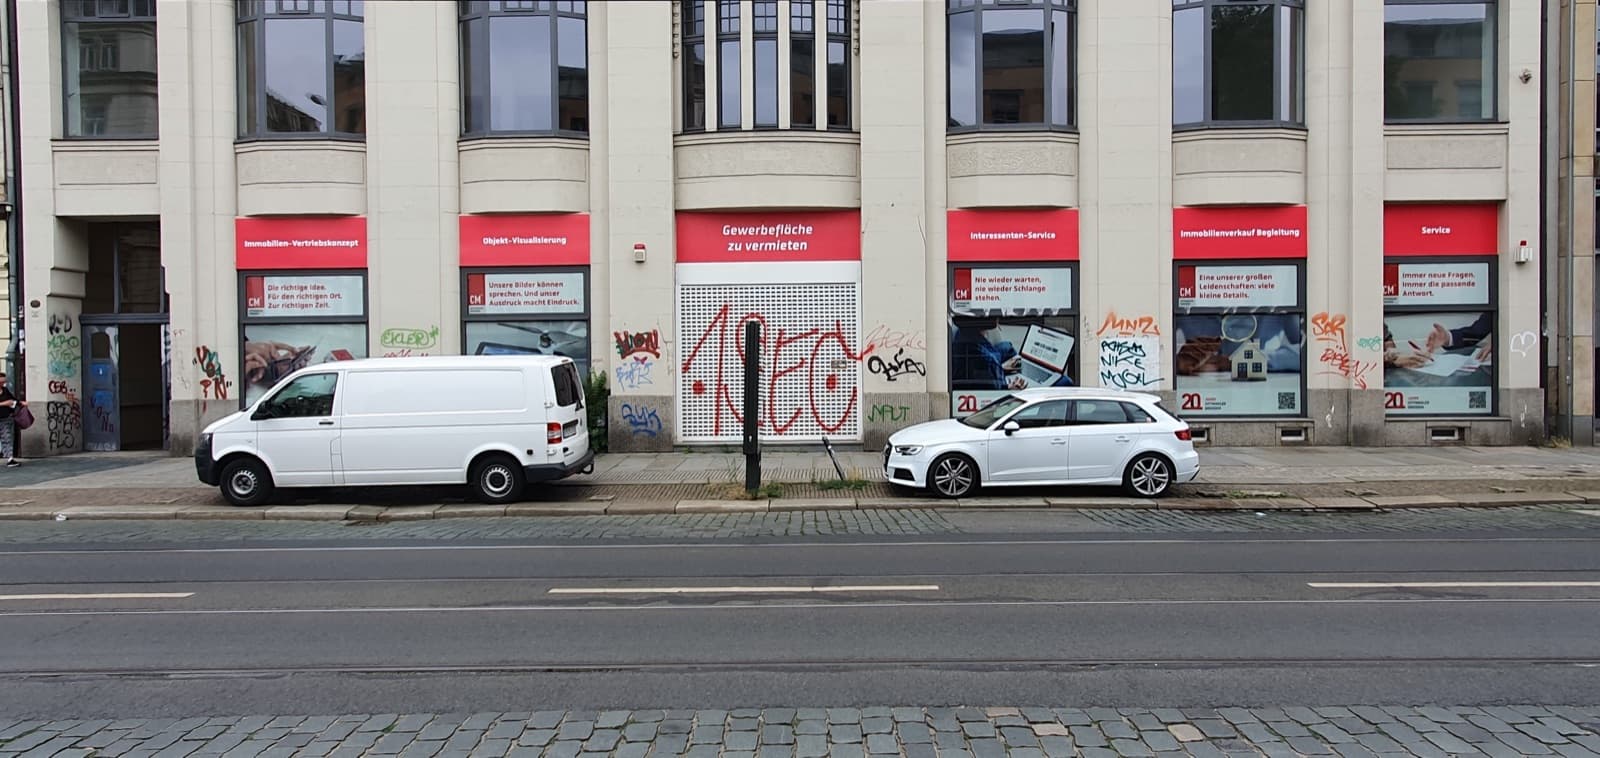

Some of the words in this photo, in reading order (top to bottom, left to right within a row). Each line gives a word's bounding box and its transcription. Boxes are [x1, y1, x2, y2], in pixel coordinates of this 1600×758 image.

[722, 224, 813, 238] Gewerbefläche
[1180, 229, 1256, 238] Immobilienverkauf
[1256, 229, 1300, 238] Begleitung
[1421, 226, 1451, 234] Service
[970, 231, 1056, 240] Interessenten-Service
[244, 239, 359, 248] Immobilien-Vertriebskonzept
[482, 236, 567, 246] Objekt-Visualisierung
[727, 242, 742, 252] zu
[745, 240, 808, 252] vermieten
[280, 284, 308, 293] richtige
[488, 281, 513, 289] Unsere
[1013, 285, 1046, 293] Schlange
[1440, 280, 1475, 289] passende
[955, 289, 968, 299] CM
[1179, 287, 1191, 297] CM
[1199, 291, 1222, 299] kleine
[1222, 291, 1250, 299] Details.
[267, 292, 280, 300] Für
[281, 292, 295, 300] den
[296, 293, 328, 302] richtigen
[329, 292, 343, 300] Ort.
[469, 294, 482, 305] CM
[248, 297, 261, 307] CM
[281, 302, 314, 311] richtigen
[547, 298, 580, 306] Eindruck.
[957, 394, 978, 412] 20
[1182, 392, 1203, 410] 20
[1384, 392, 1406, 409] 20
